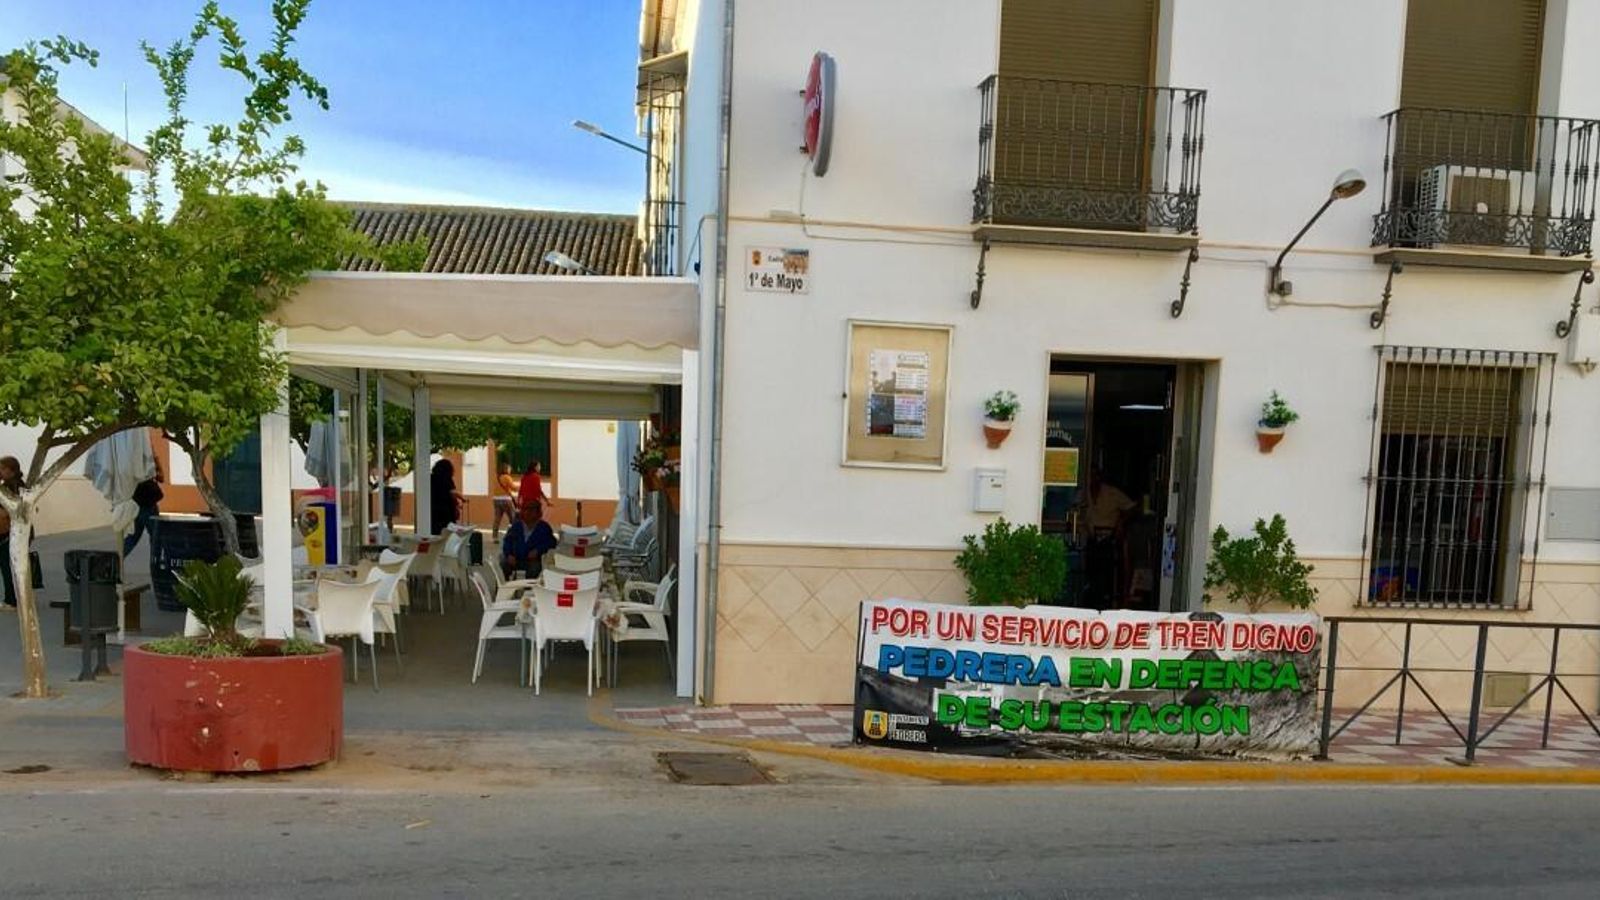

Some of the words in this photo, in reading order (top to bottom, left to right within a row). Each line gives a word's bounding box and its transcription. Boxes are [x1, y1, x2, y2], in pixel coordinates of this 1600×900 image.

[761, 272, 774, 288] de
[776, 273, 803, 293] Mayo
[871, 606, 929, 638] POR
[936, 611, 976, 641] UN
[981, 614, 1110, 649] SERVICIO
[1113, 621, 1150, 650] DE
[1156, 621, 1227, 651] TREN
[1232, 623, 1316, 654] DIGNO
[877, 644, 1062, 687] PEDRERA
[1068, 656, 1122, 689] EN
[1129, 658, 1301, 692] DEFENSA
[936, 693, 992, 728] DE
[999, 699, 1051, 732] SU
[1058, 698, 1250, 736] ESTACIÓN
